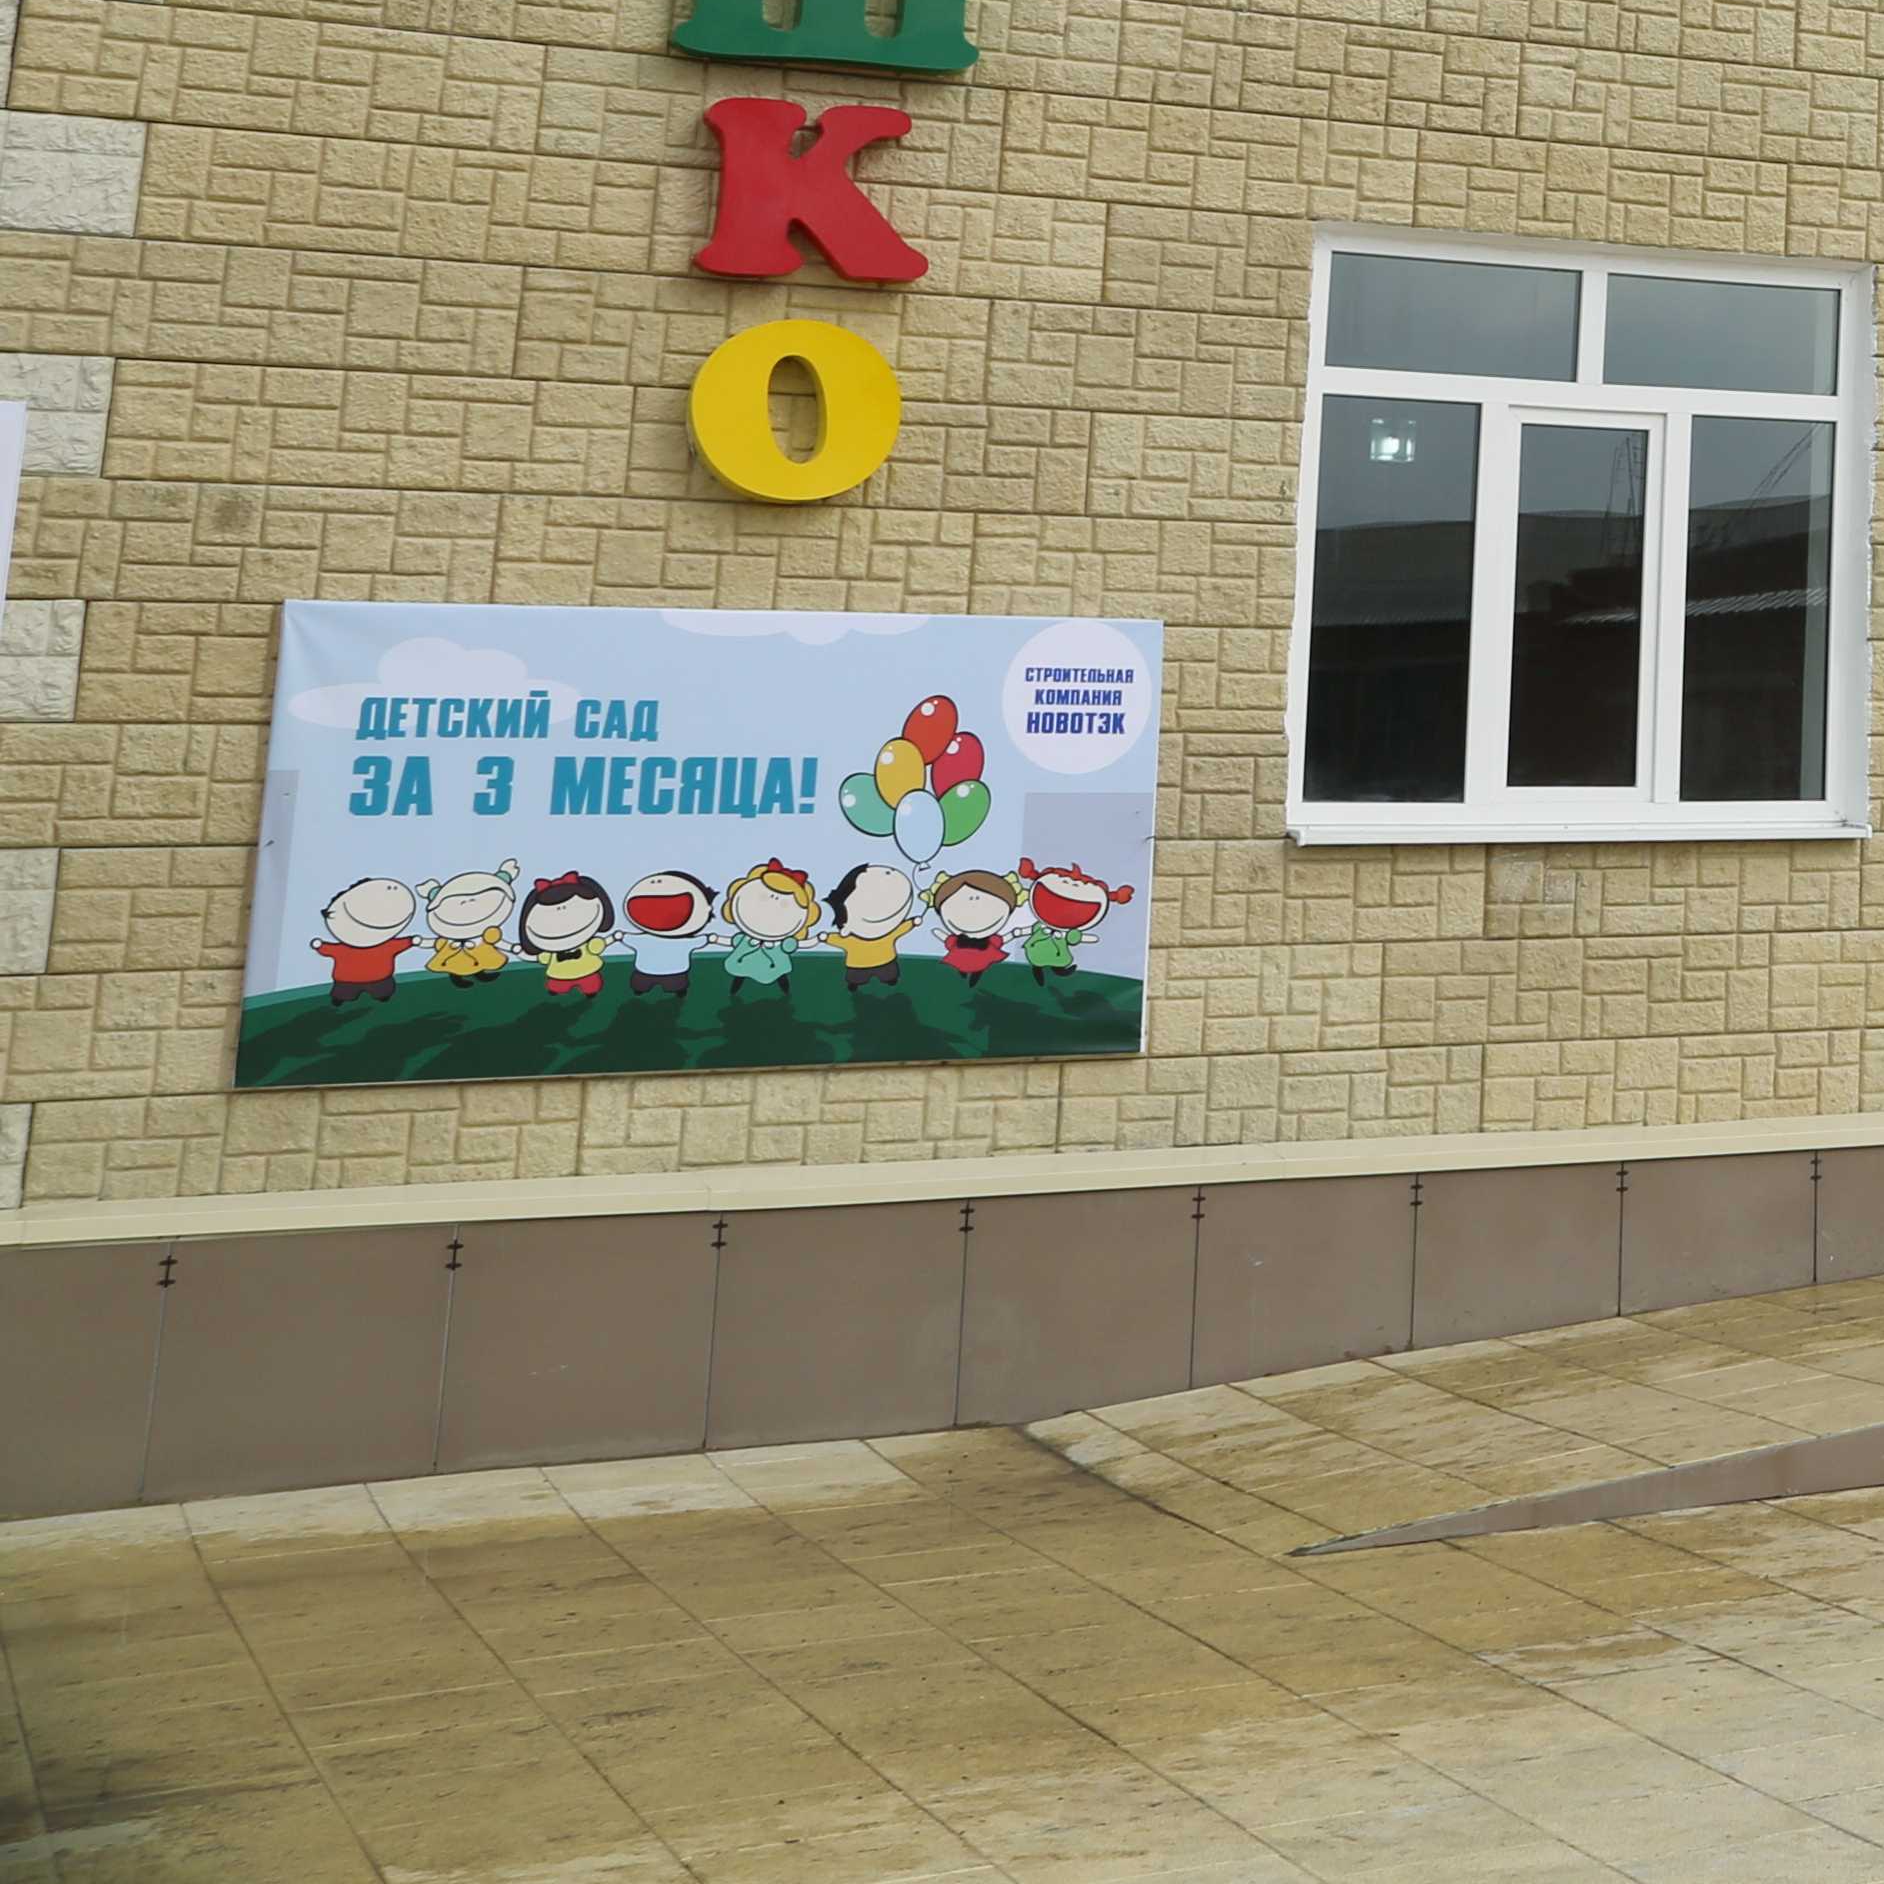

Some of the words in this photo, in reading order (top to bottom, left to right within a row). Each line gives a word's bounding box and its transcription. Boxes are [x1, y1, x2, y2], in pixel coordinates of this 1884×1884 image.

[1024, 667, 1135, 684] СТРОИТЕЛЬНАЯ
[1034, 689, 1123, 706] КОМПАНИЯ
[354, 690, 551, 742] ДЕТСКИЙ
[573, 699, 660, 743] САД
[1025, 711, 1126, 735] НОВОТЭК
[347, 755, 434, 817] ЗА
[548, 755, 820, 819] МЕСЯЦА!
